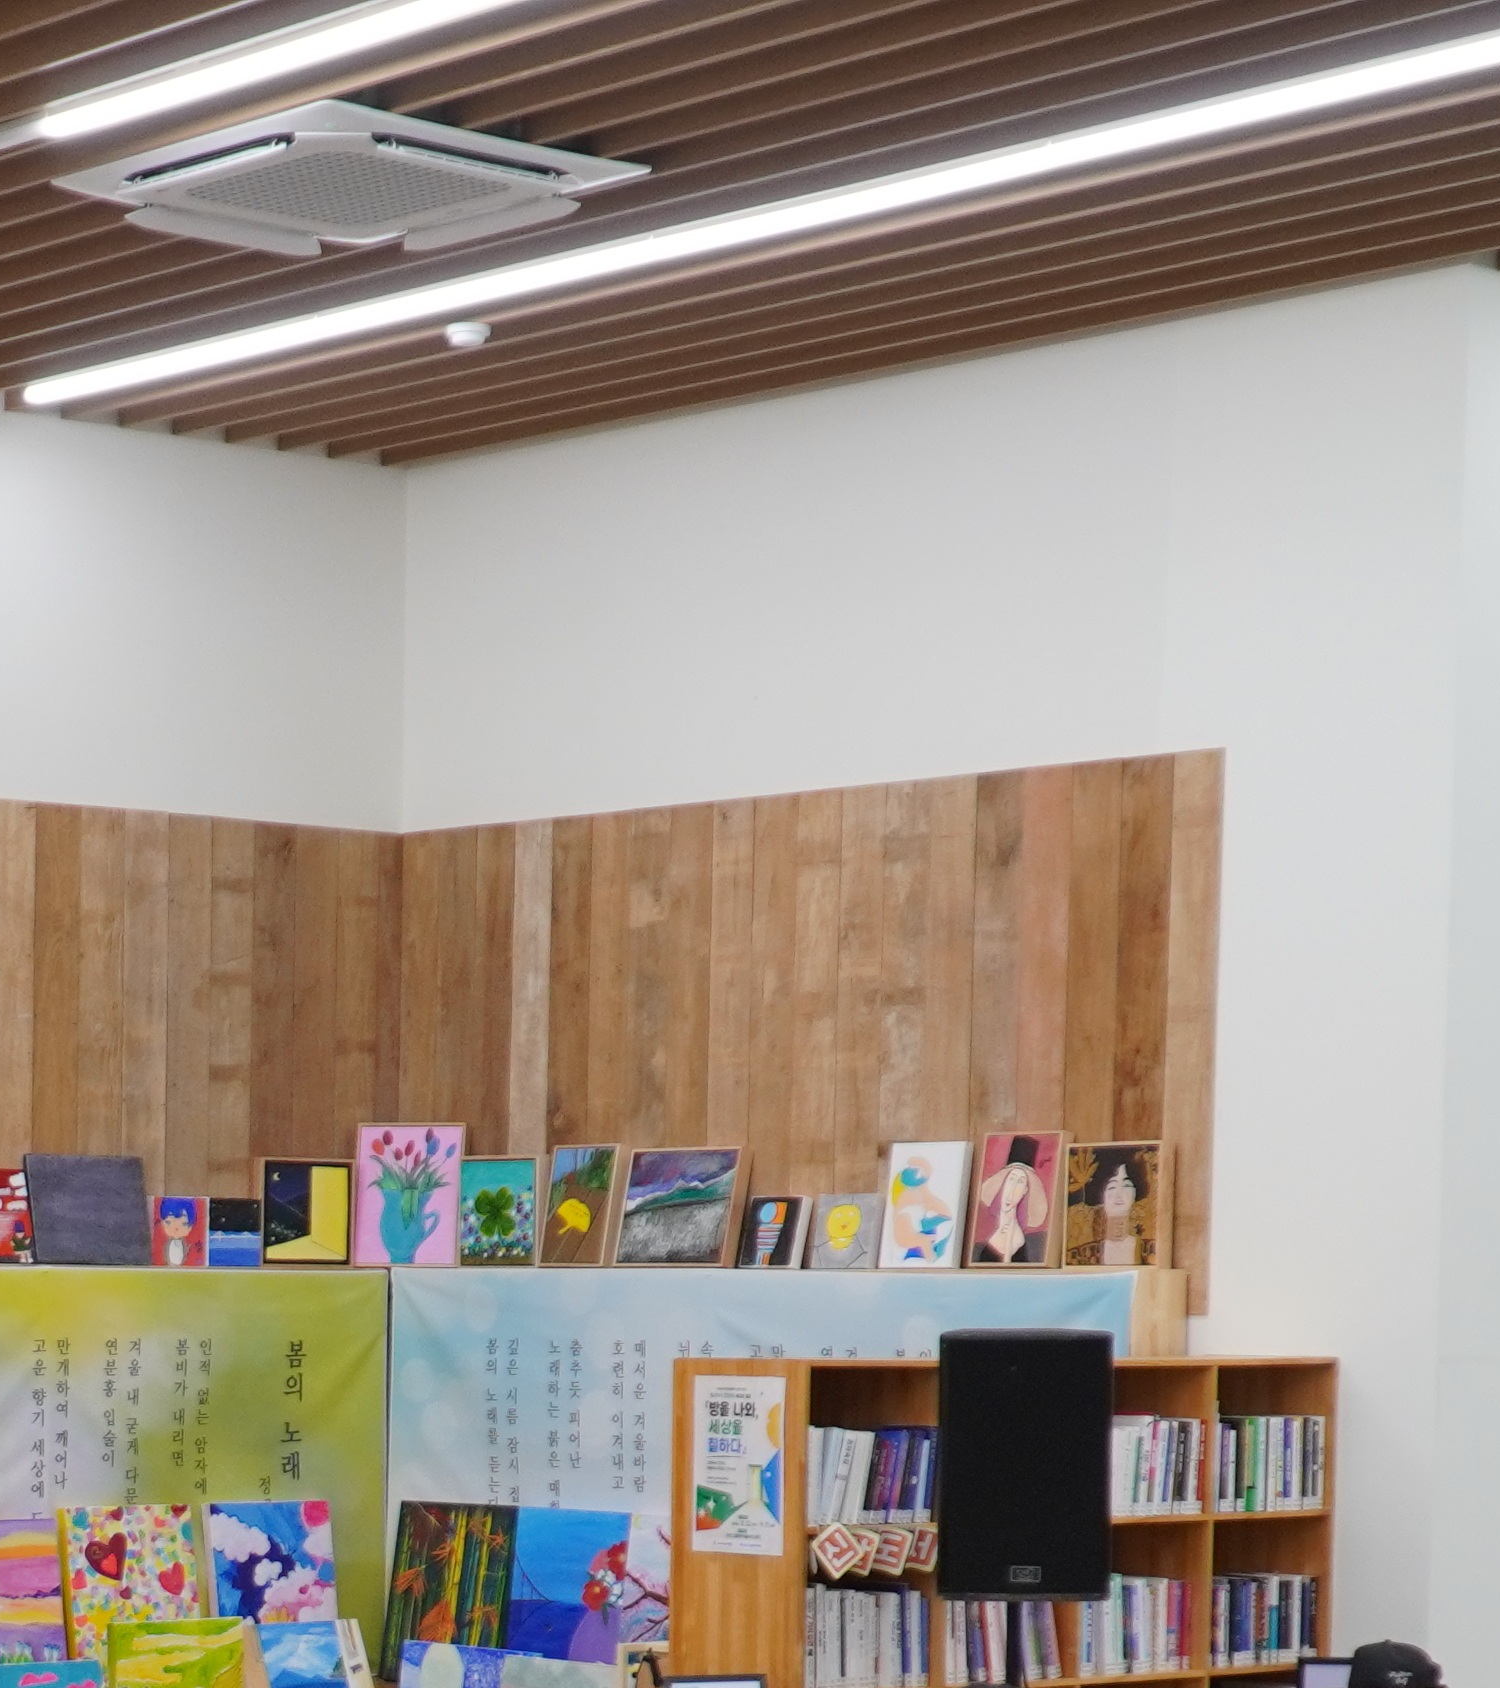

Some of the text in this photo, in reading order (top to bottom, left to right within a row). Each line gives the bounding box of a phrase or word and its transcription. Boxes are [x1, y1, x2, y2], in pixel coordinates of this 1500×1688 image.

[32, 1339, 47, 1376] 고운
[56, 1337, 71, 1418] 만개하여
[486, 1338, 499, 1376] 봄의
[506, 1338, 519, 1376] 깊은
[548, 1340, 561, 1419] 노래하는
[31, 1388, 47, 1427] 향기
[102, 1337, 118, 1468] 연분홍 입술이
[125, 1338, 141, 1505] 겨울 내 굳게 다문
[172, 1338, 189, 1467] 봄비가 내리면
[194, 1338, 212, 1495] 인적 없는 암자에
[280, 1340, 307, 1481] 봄의 노래
[486, 1388, 499, 1445] 노래를
[506, 1387, 519, 1425] 시름
[569, 1338, 583, 1469] 춤추듯 피어난
[611, 1339, 624, 1490] 호련히 이겨내고
[633, 1339, 646, 1493] 매서운 겨울바람
[709, 1419, 743, 1435] 세상을
[30, 1438, 46, 1498] 세상에
[507, 1436, 519, 1474] 잠시
[547, 1430, 560, 1468] 붉은
[259, 1476, 271, 1502] 정
